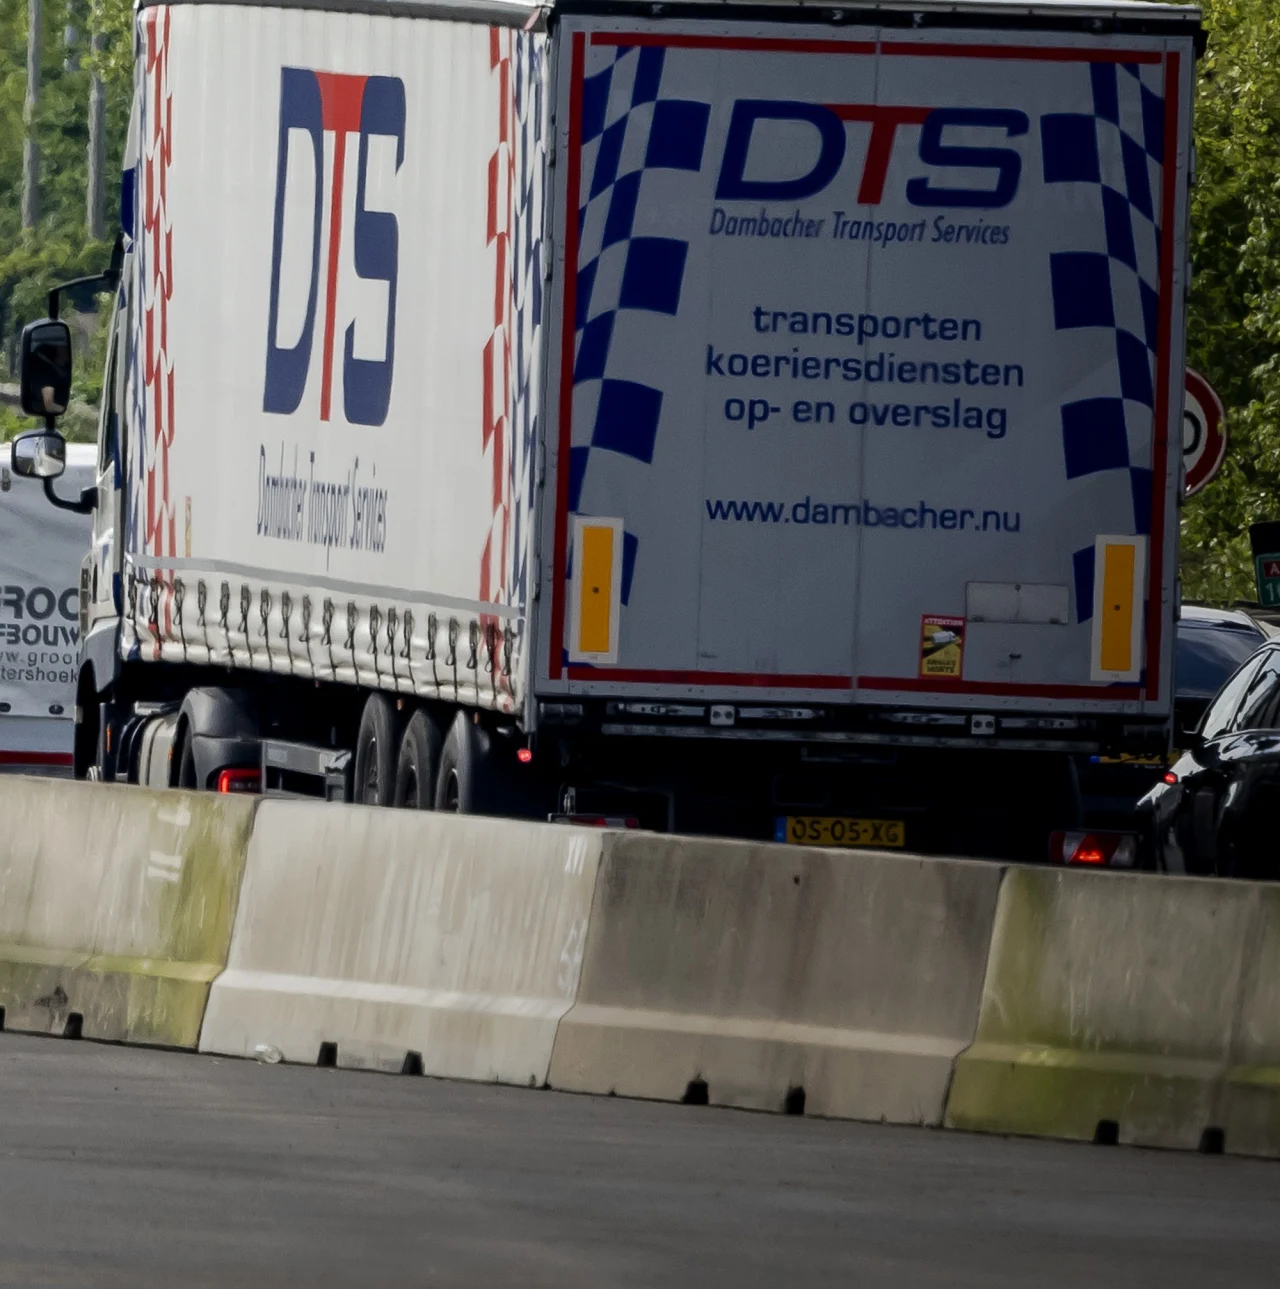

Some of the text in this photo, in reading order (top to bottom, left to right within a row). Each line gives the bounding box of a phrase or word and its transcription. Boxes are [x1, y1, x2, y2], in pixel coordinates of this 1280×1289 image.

[714, 99, 1030, 208] DTS
[263, 66, 406, 427] DTS
[709, 208, 1010, 248] Dambacher Transport Services
[753, 306, 981, 345] transporten
[705, 344, 1024, 387] koeriersdiensten
[724, 397, 1007, 439] op- en overslag
[705, 496, 1021, 532] www.dambacher.nu
